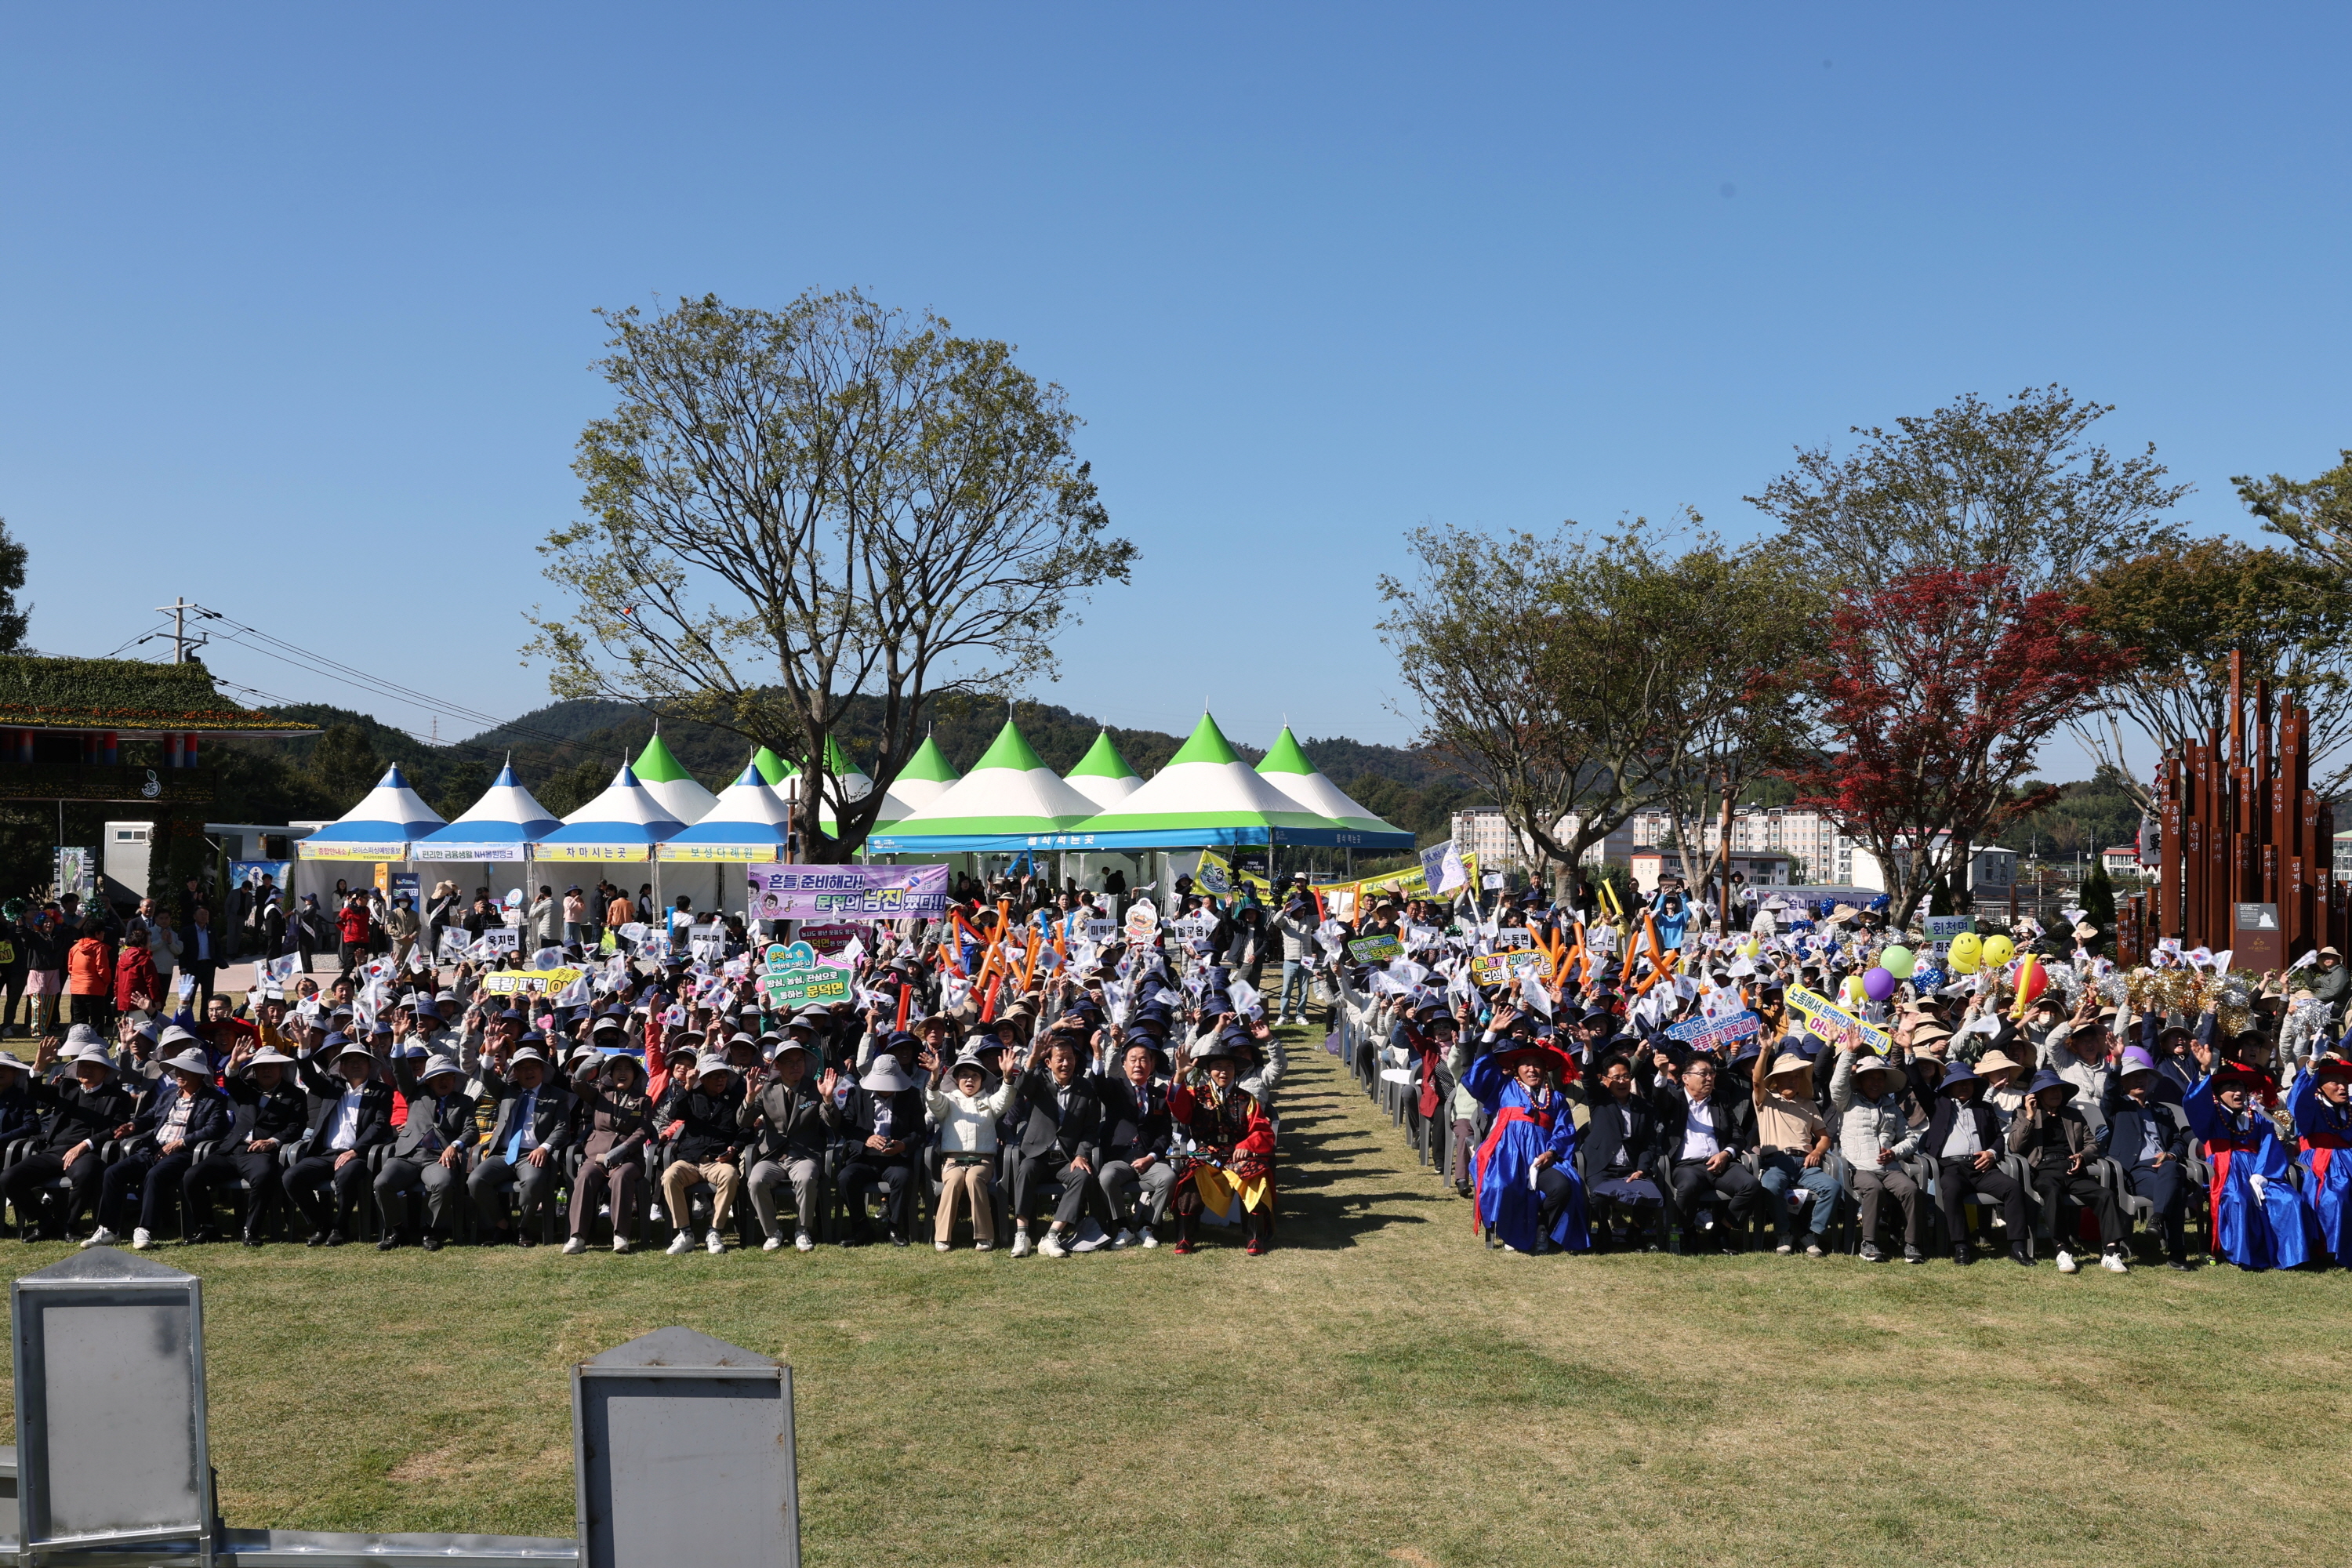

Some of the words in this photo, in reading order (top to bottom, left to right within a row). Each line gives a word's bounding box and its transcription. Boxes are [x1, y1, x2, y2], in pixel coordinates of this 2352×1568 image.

[2196, 753, 2205, 781] 우치적
[2273, 783, 2282, 813] 고득장
[2170, 805, 2180, 835] 송희립
[2190, 821, 2199, 851] 송덕일
[318, 848, 347, 856] 종합안내소
[422, 850, 443, 859] 편리한
[768, 873, 799, 890] 흔들
[800, 873, 865, 891] 준비해라!
[2317, 873, 2326, 904] 정사제
[815, 894, 862, 912] 문덕의
[862, 887, 904, 913] 남진
[904, 893, 946, 911] 떴다!!
[1933, 921, 1968, 935] 회천면
[770, 951, 793, 962] 문덕에
[1936, 942, 1951, 953] 회천
[1475, 959, 1487, 970] 늘,
[1509, 952, 1541, 966] 같이는
[488, 976, 517, 992] 득량
[517, 976, 548, 993] 파워
[767, 978, 786, 989] 땅심,
[786, 976, 805, 985] 농심,
[779, 989, 804, 1000] 통하는
[806, 982, 844, 998] 문덕면
[1788, 987, 1824, 1014] 노동에서
[1739, 1016, 1759, 1034] 피네!
